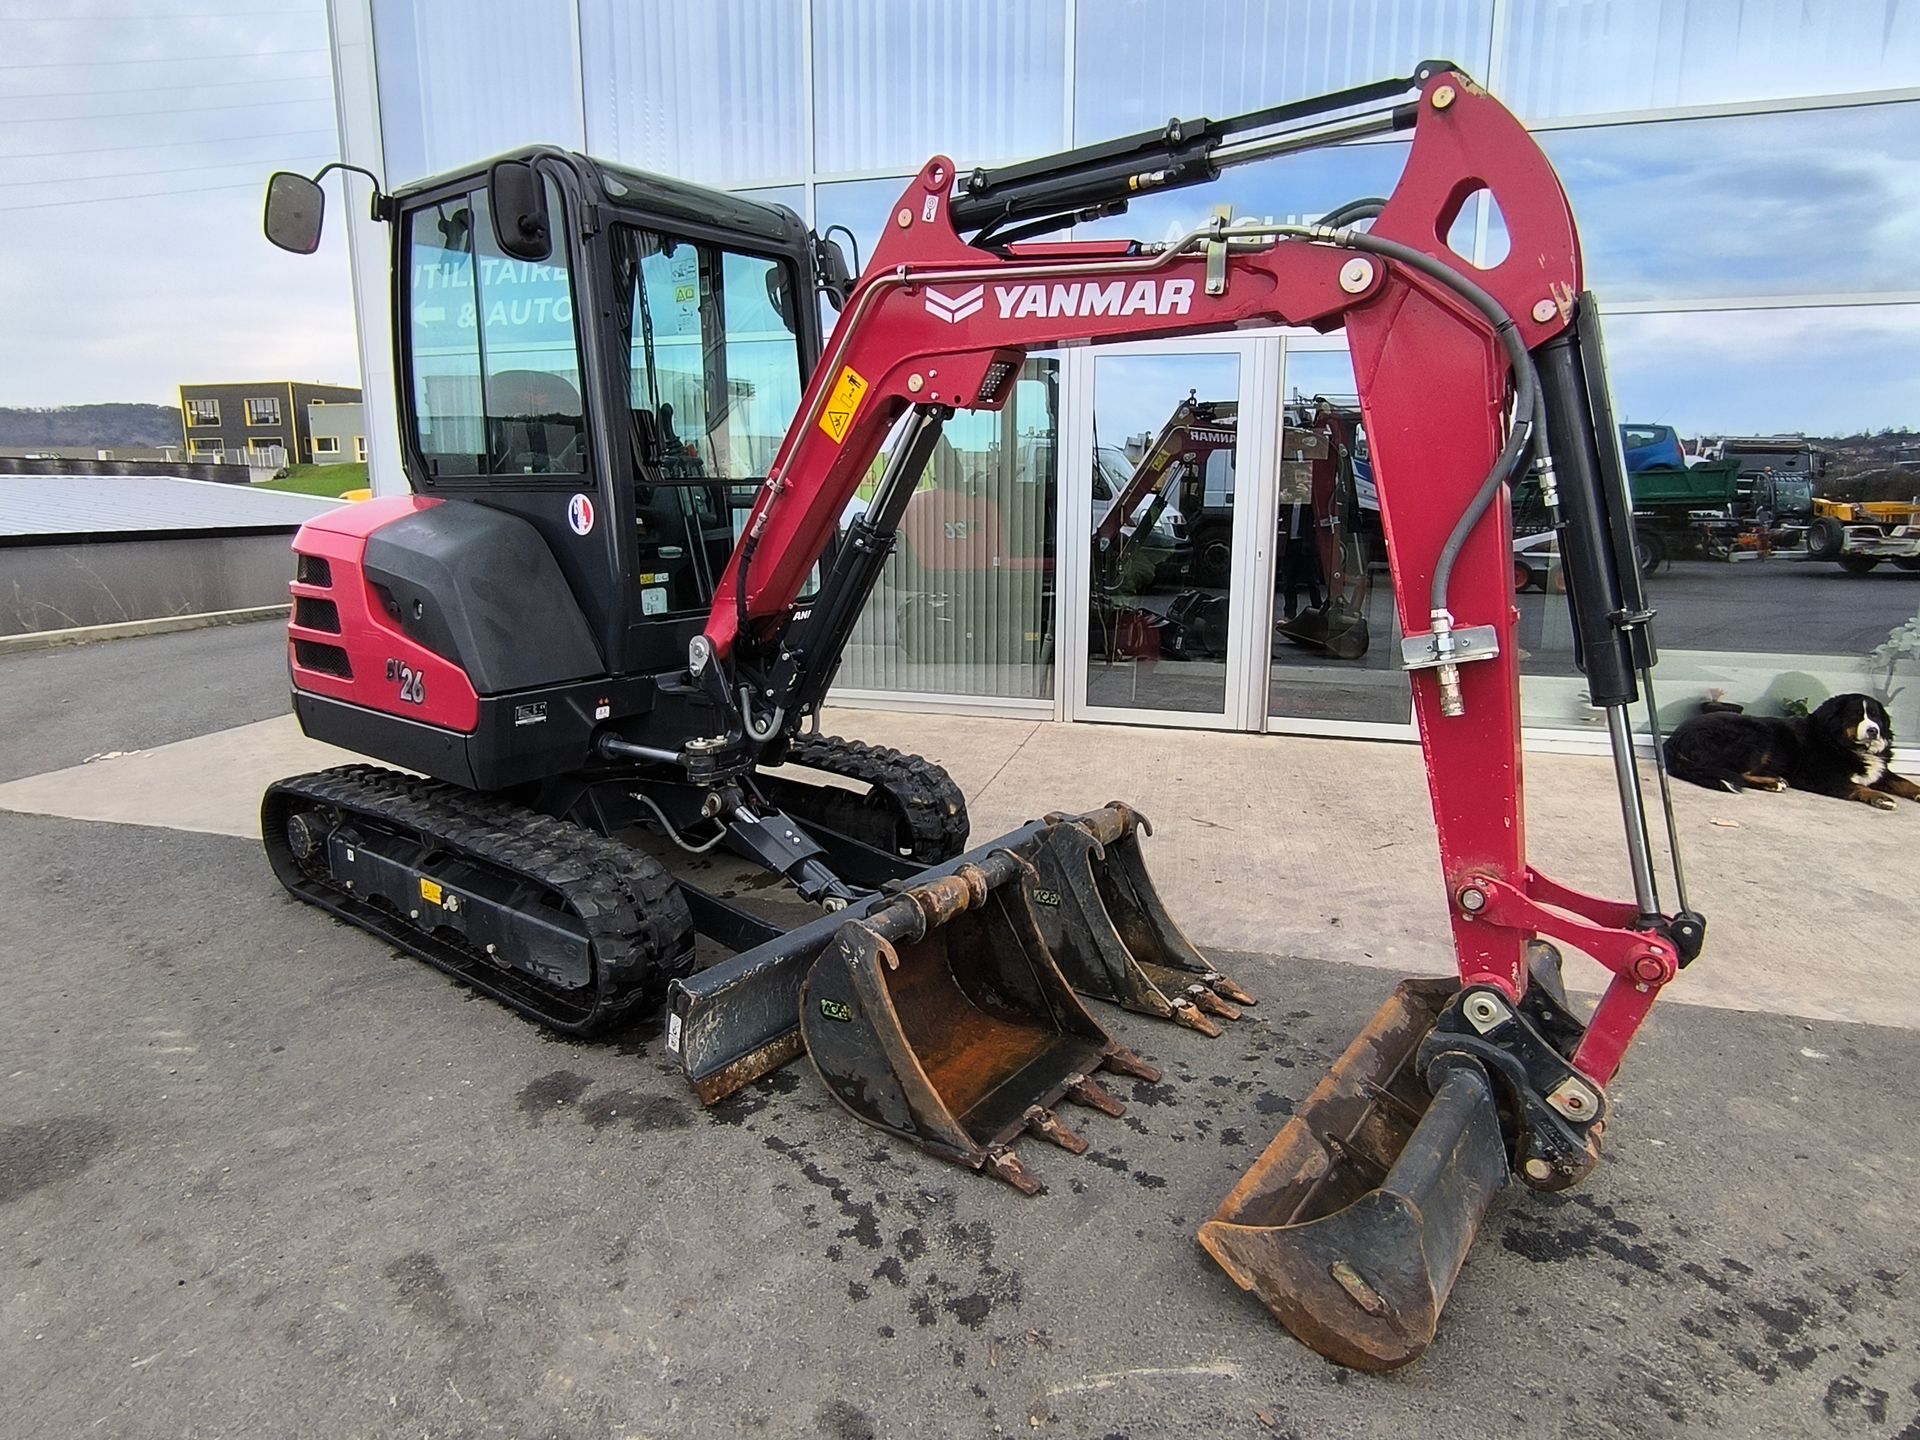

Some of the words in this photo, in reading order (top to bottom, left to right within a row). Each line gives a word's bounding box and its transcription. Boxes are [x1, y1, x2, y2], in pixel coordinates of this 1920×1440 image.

[413, 259, 569, 289] TILTAIRE
[994, 278, 1195, 319] YANMAR
[400, 667, 426, 705] 26
